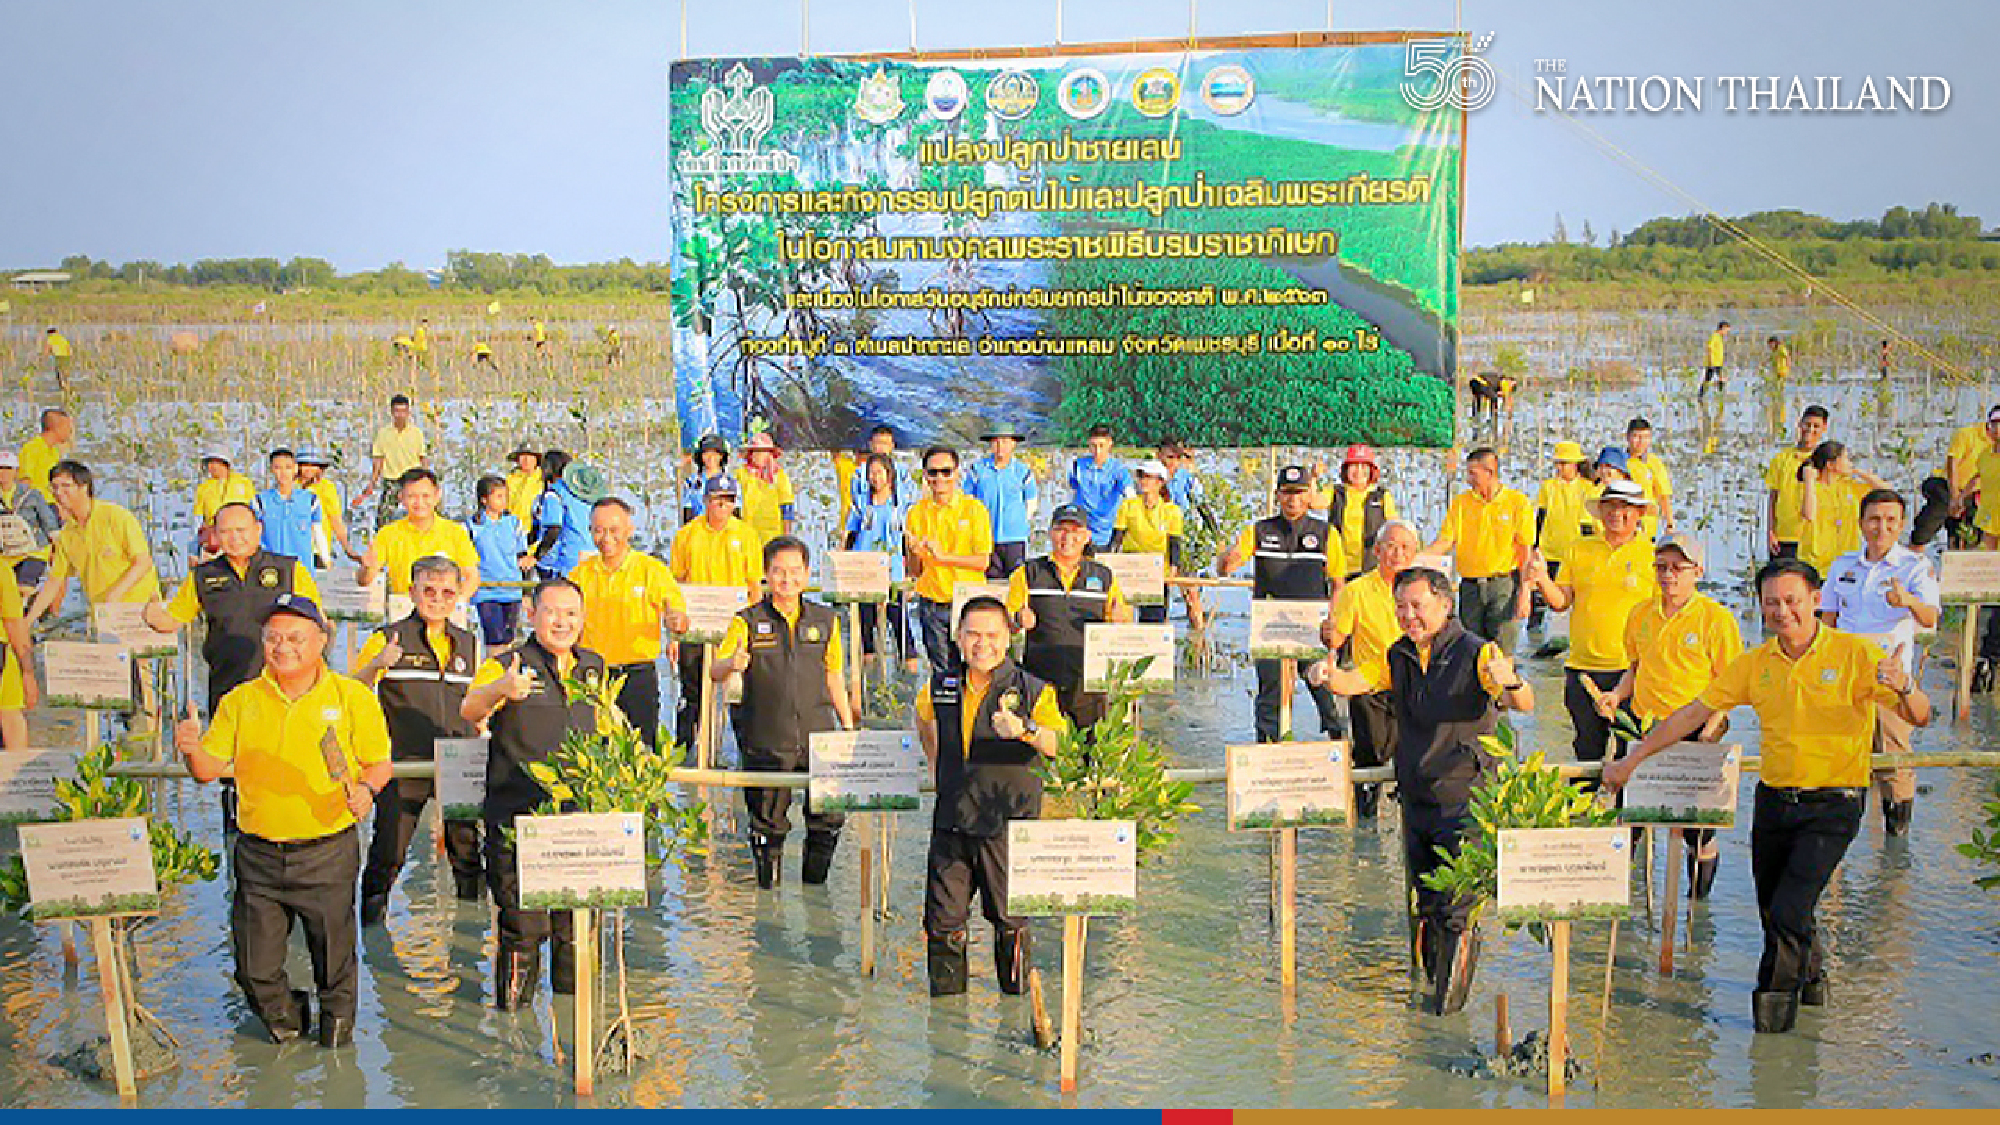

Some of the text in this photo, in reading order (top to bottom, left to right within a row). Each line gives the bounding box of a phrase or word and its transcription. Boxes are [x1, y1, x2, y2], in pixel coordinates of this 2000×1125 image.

[919, 129, 1182, 169] แปลงปลูกป่าชายเลน
[694, 172, 1431, 217] โครงการและกิจกรรมปลูกต้นไม้และปลูกป่าเฉลิมพระเกียรติ
[776, 227, 1337, 262] ในโอกาสมหามงคลพระราชพิธีบรมราชาภิเษก
